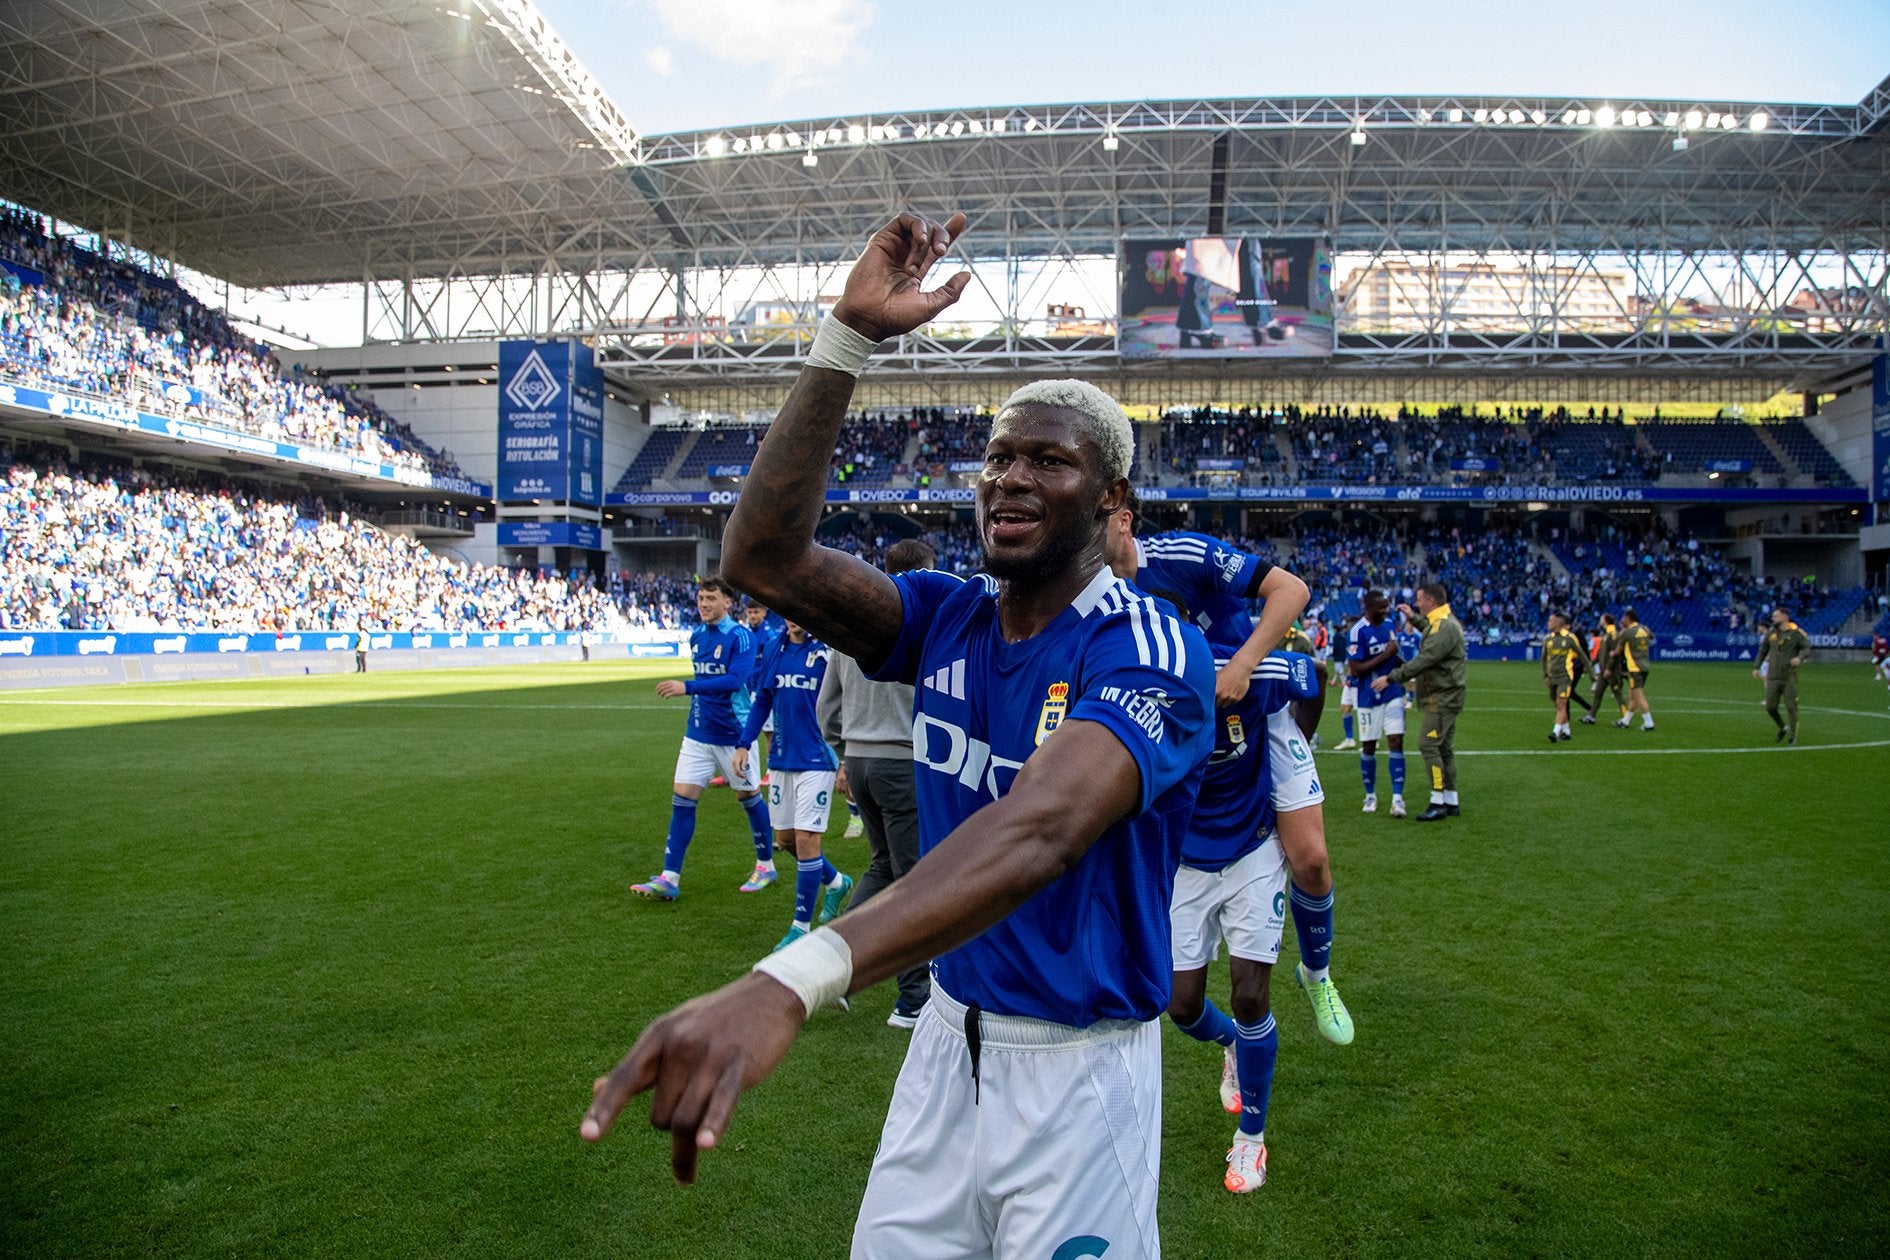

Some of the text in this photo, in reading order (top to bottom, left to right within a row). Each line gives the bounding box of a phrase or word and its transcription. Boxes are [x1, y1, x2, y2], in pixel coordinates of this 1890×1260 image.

[506, 434, 559, 449] SERIGRAFÍA
[506, 448, 559, 461] ROTULACIÓN
[1222, 553, 1243, 583] INTEGRA
[1100, 686, 1164, 745] INTEGRA
[1360, 713, 1372, 725] 31
